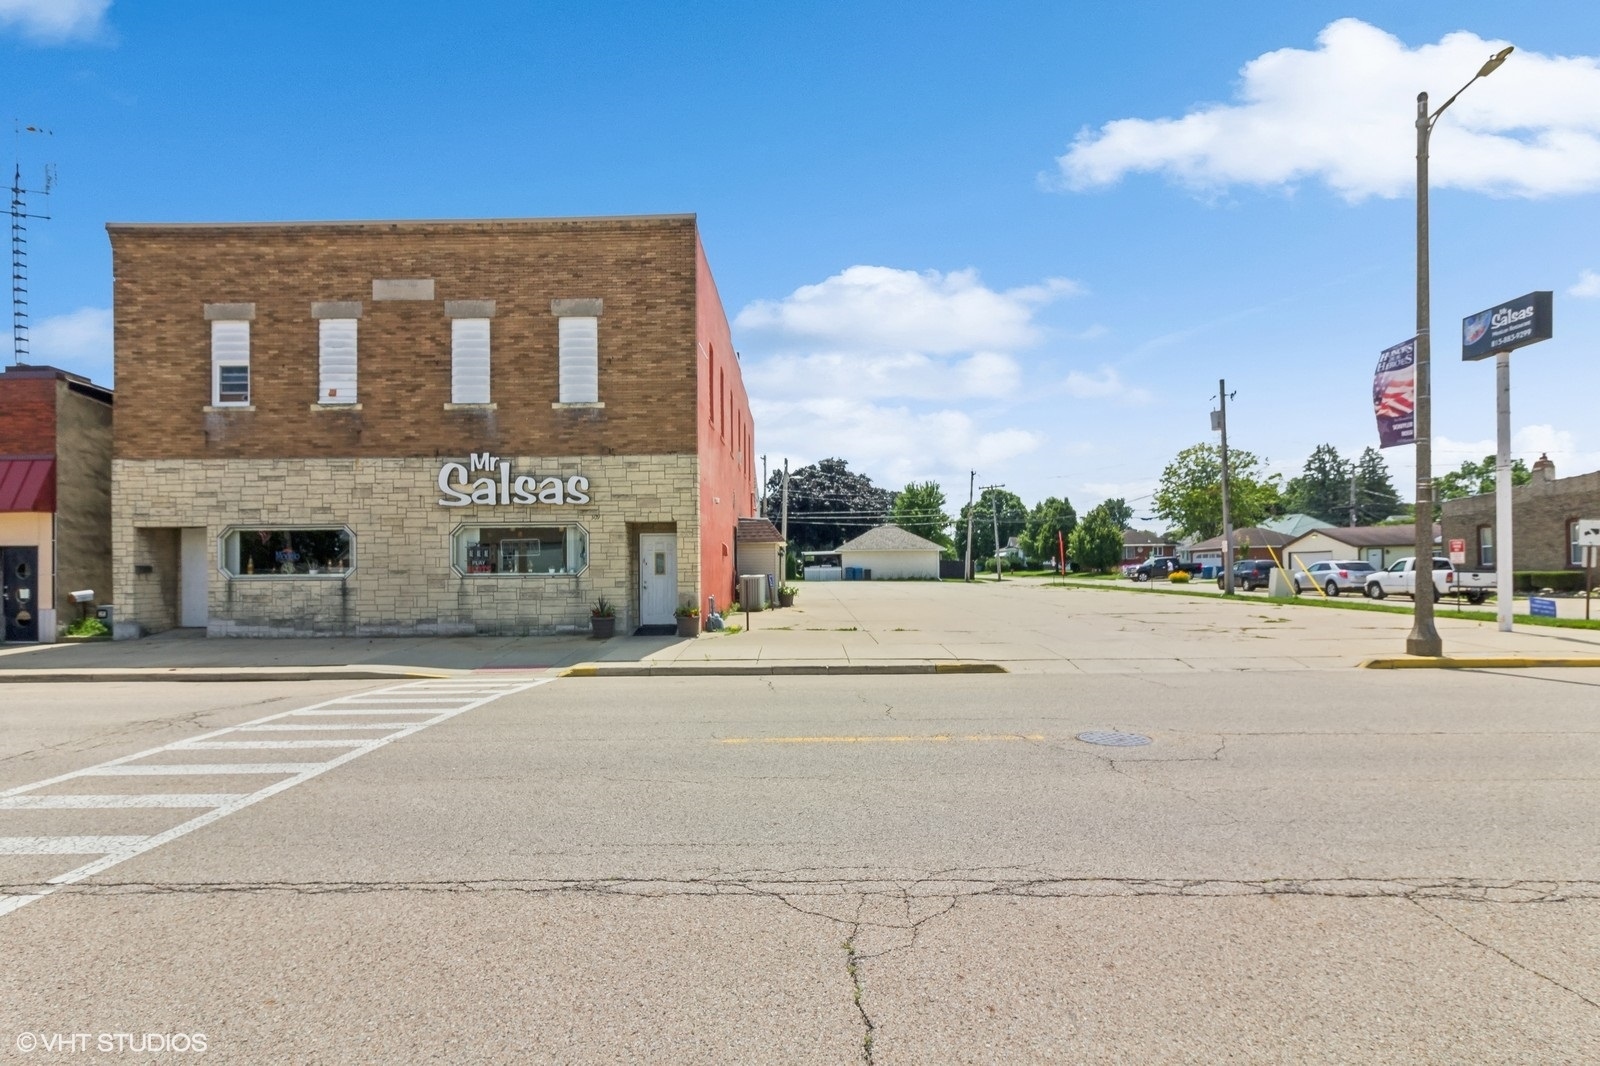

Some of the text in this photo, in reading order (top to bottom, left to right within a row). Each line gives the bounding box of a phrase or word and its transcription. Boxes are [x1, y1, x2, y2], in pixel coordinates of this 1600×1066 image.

[1491, 306, 1534, 329] Salsas
[470, 452, 499, 471] Mr
[438, 462, 590, 506] Salsas
